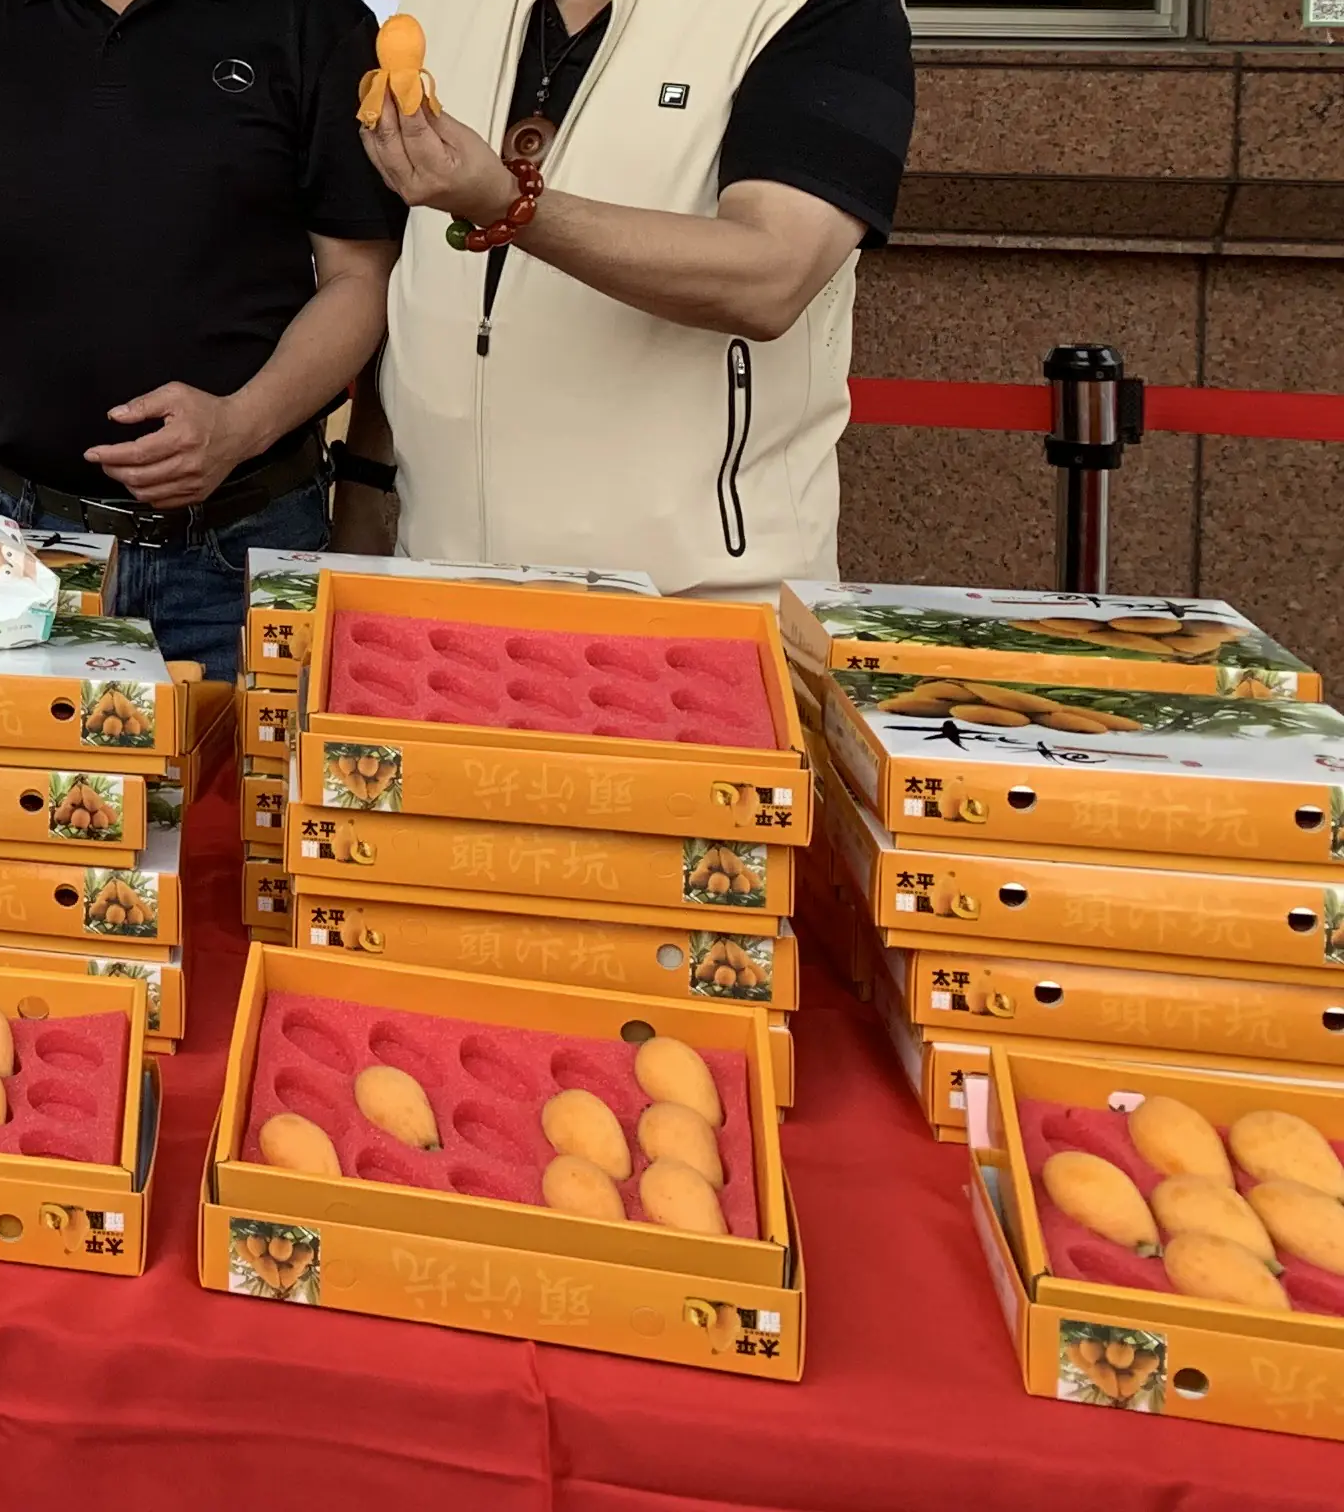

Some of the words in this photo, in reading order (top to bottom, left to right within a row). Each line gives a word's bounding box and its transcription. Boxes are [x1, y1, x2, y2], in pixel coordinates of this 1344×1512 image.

[263, 624, 294, 639] 太平
[904, 776, 943, 795] 太平
[302, 819, 336, 838] 太平
[755, 811, 792, 828] 太平
[896, 871, 935, 890] 太平
[311, 907, 345, 925] 太平
[932, 969, 970, 988] 太平
[85, 1235, 124, 1256] 太平
[735, 1335, 780, 1359] 太平
